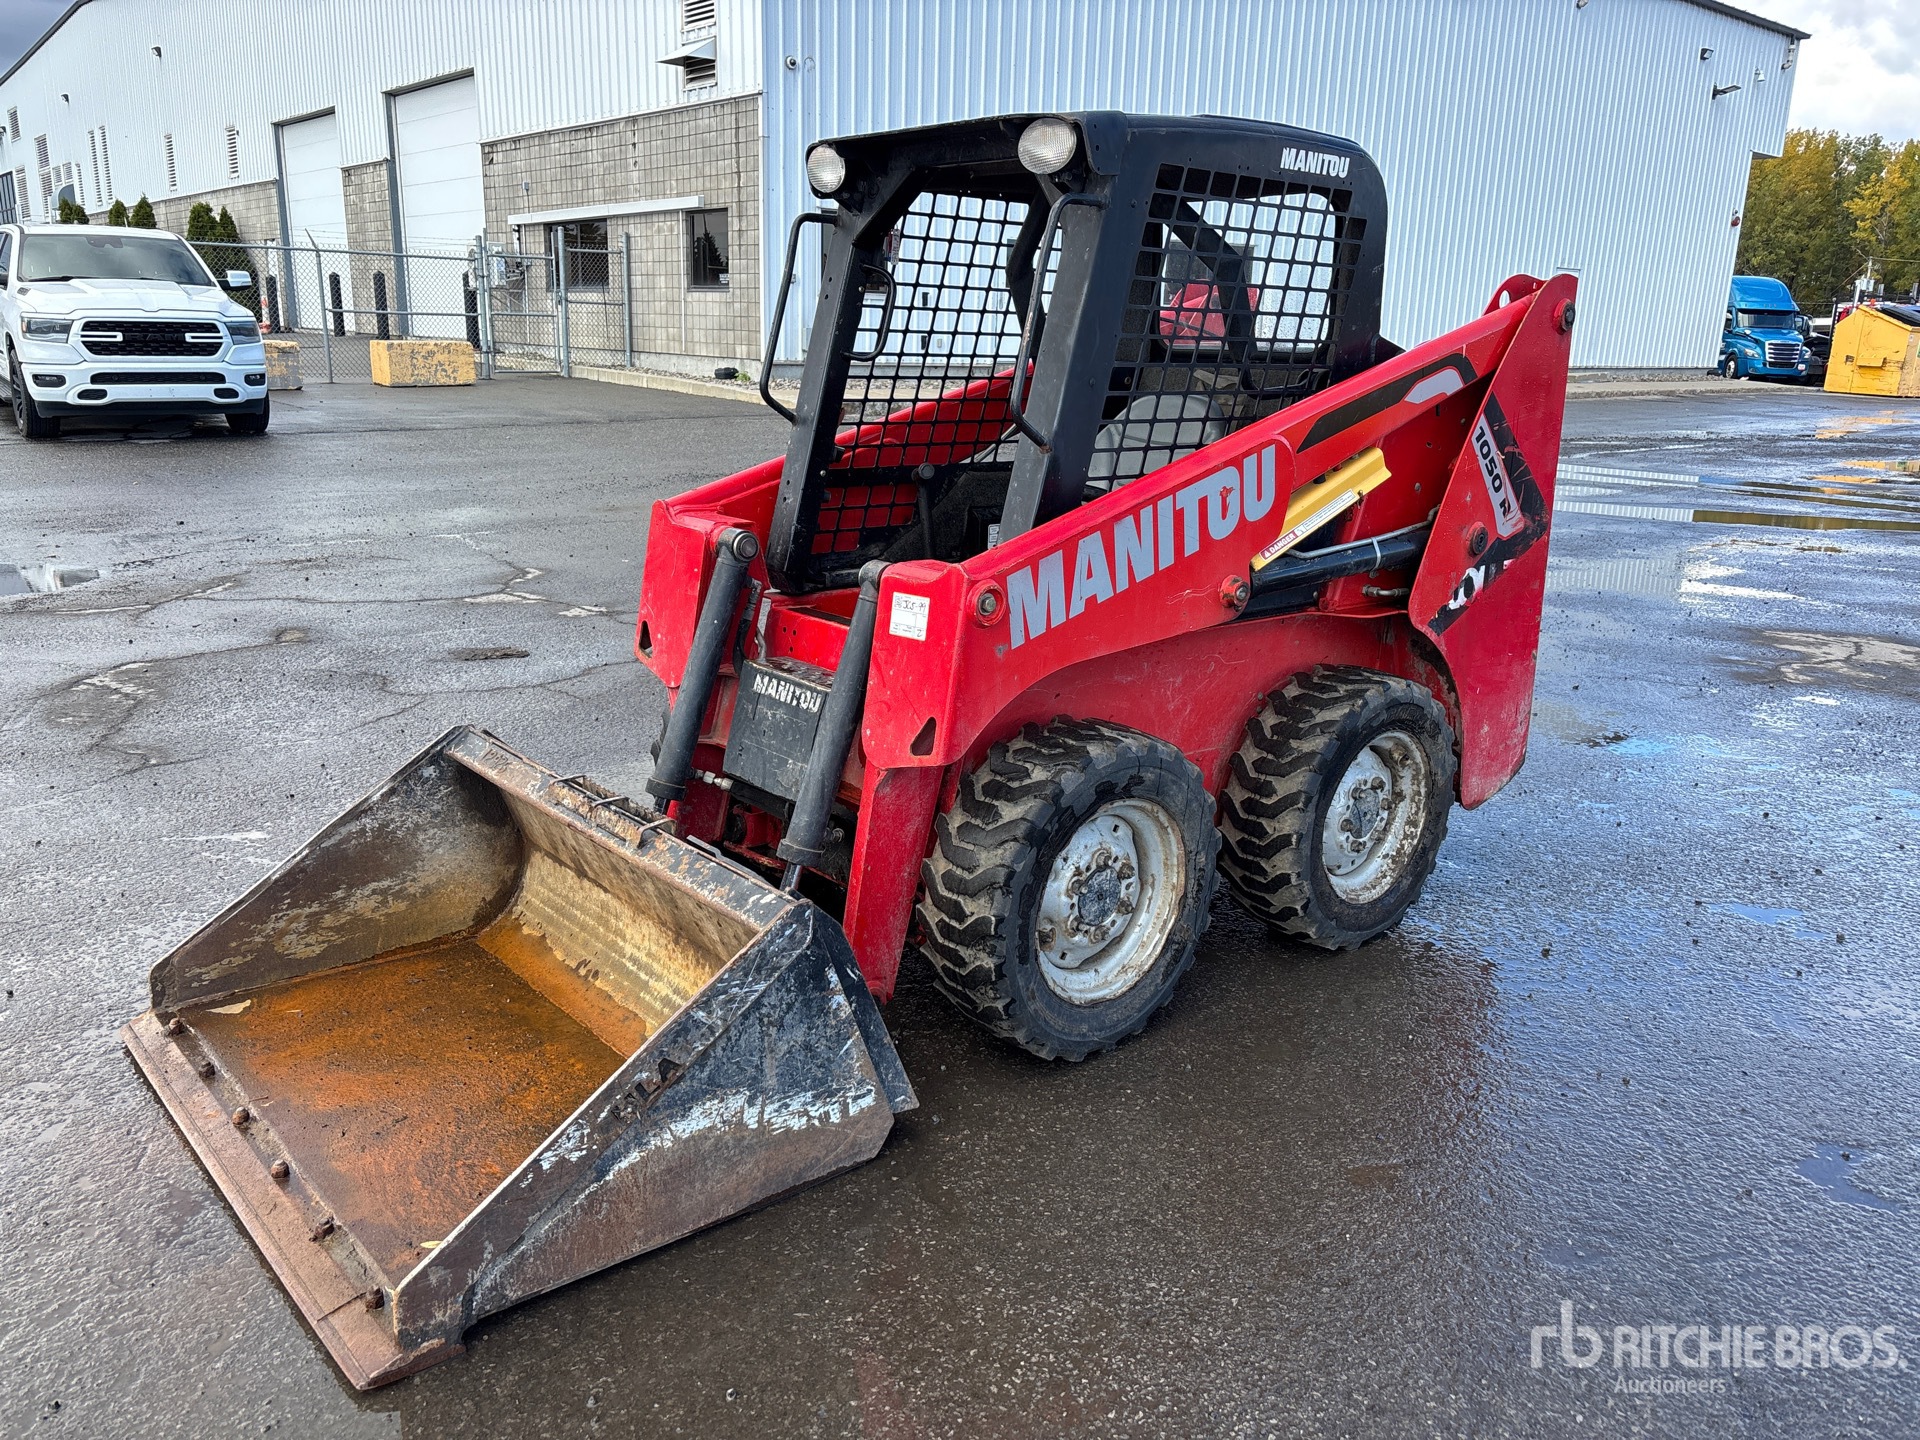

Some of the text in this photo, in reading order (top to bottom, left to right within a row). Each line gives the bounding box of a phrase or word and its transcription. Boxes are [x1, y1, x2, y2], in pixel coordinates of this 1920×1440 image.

[1280, 147, 1350, 178] MANITOU
[125, 332, 184, 341] RAM
[1475, 426, 1503, 493] 1050
[1006, 444, 1276, 650] MANITOU
[1269, 533, 1296, 555] DANGER
[752, 673, 822, 713] MANITOU
